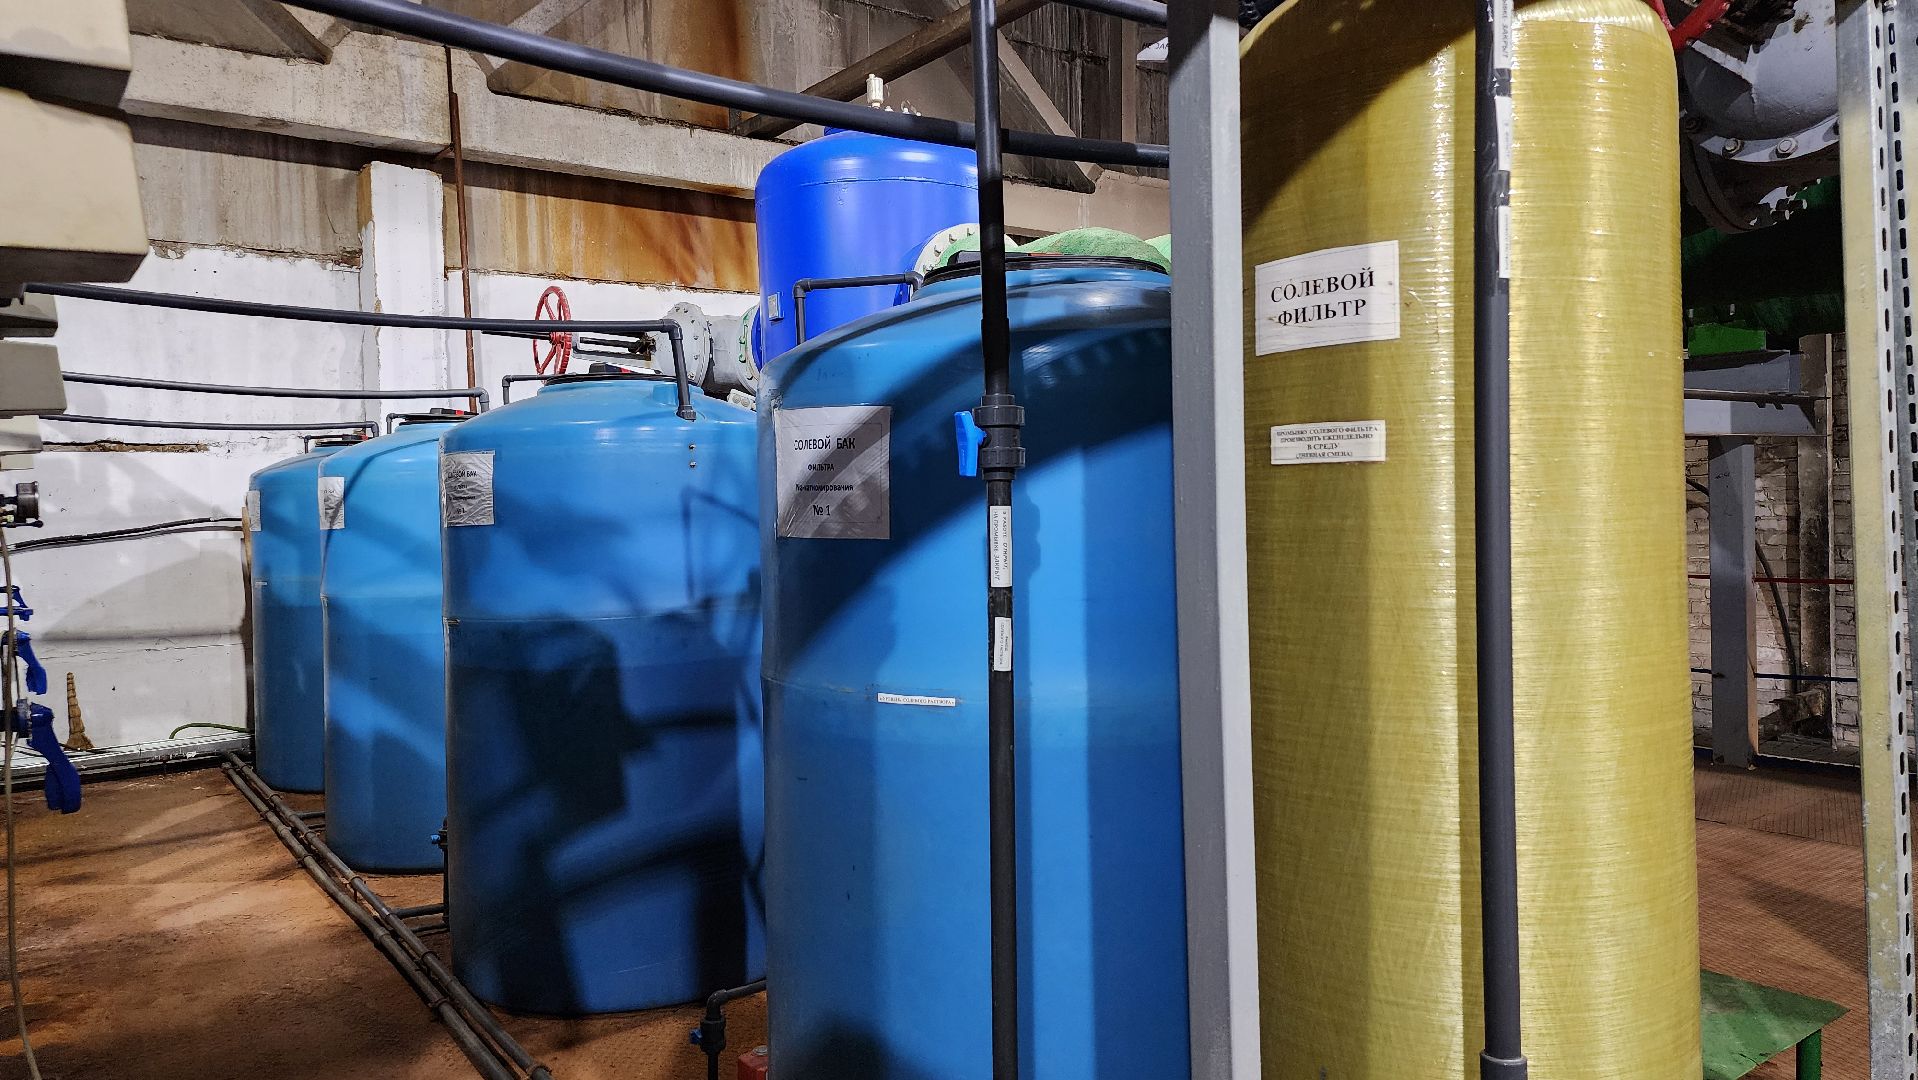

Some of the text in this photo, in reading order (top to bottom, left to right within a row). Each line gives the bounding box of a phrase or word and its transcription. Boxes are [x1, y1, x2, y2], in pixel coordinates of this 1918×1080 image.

[1270, 266, 1375, 303] СОЛЕВОЙ
[1278, 299, 1367, 326] ФИЛЬТР
[793, 435, 856, 451] СОЛЕВОЙ БАК
[1313, 442, 1340, 450] СРЕДУ
[825, 505, 831, 516] 1
